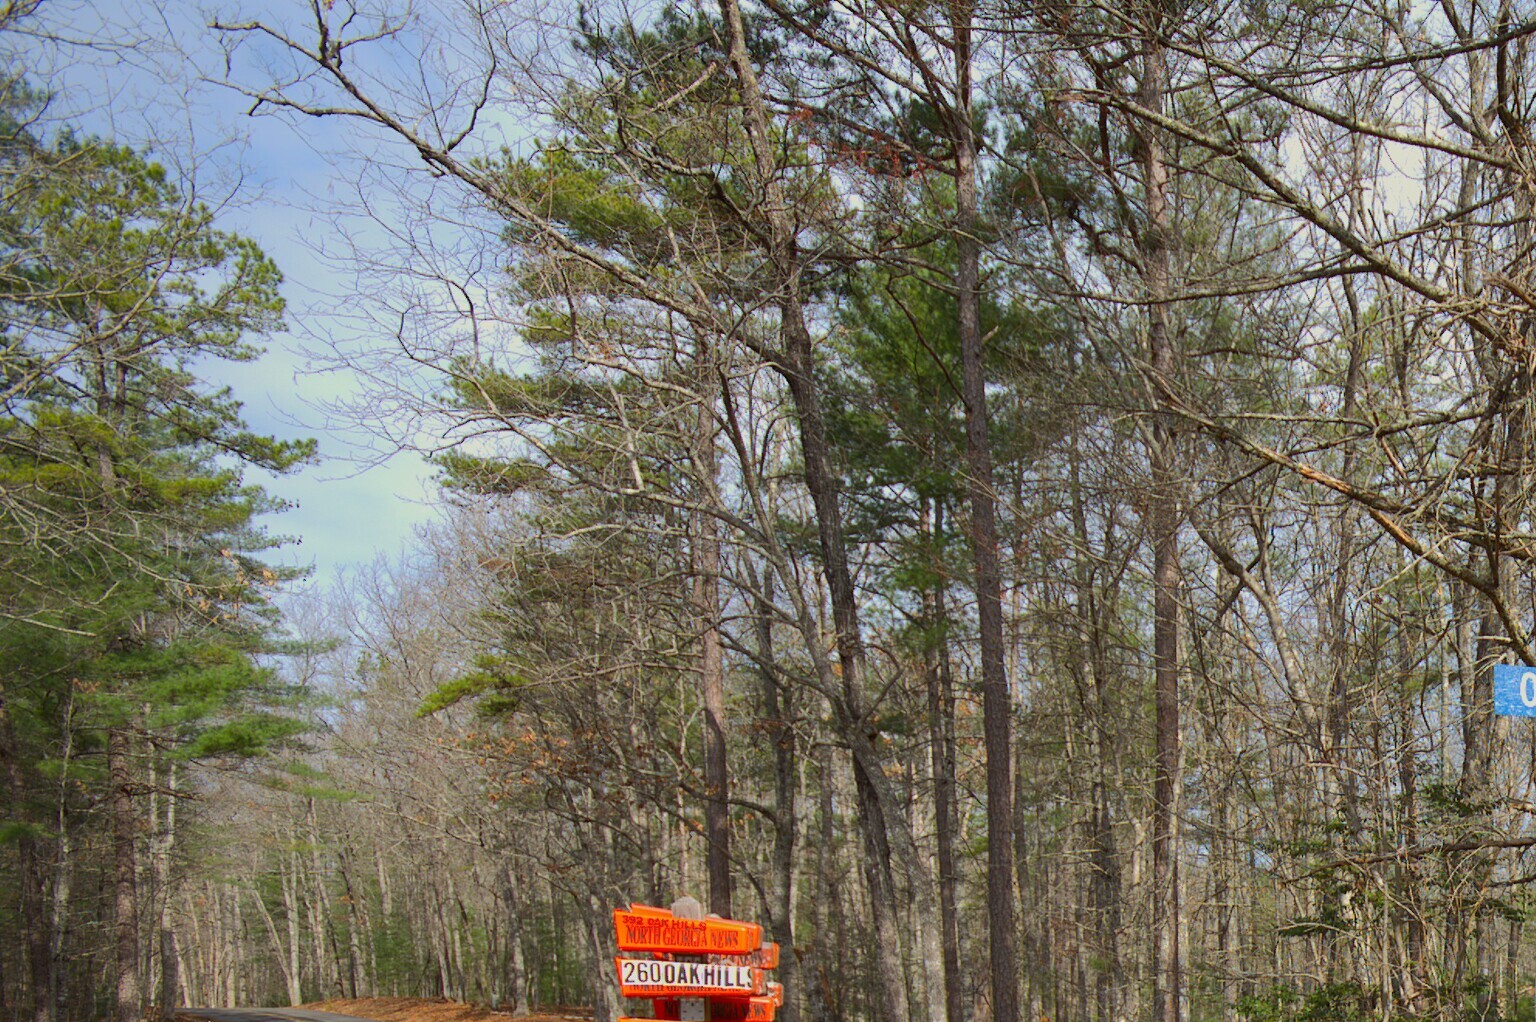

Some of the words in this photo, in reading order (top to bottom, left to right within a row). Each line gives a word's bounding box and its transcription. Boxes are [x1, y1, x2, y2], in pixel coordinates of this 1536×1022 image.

[622, 915, 644, 925] 392
[647, 918, 669, 927] OAK
[672, 919, 707, 931] HILLS
[626, 925, 661, 945] NORTH
[663, 927, 708, 946] GEORGIA
[711, 930, 738, 948] NEWS
[624, 962, 661, 984] 260
[664, 963, 700, 985] OAK
